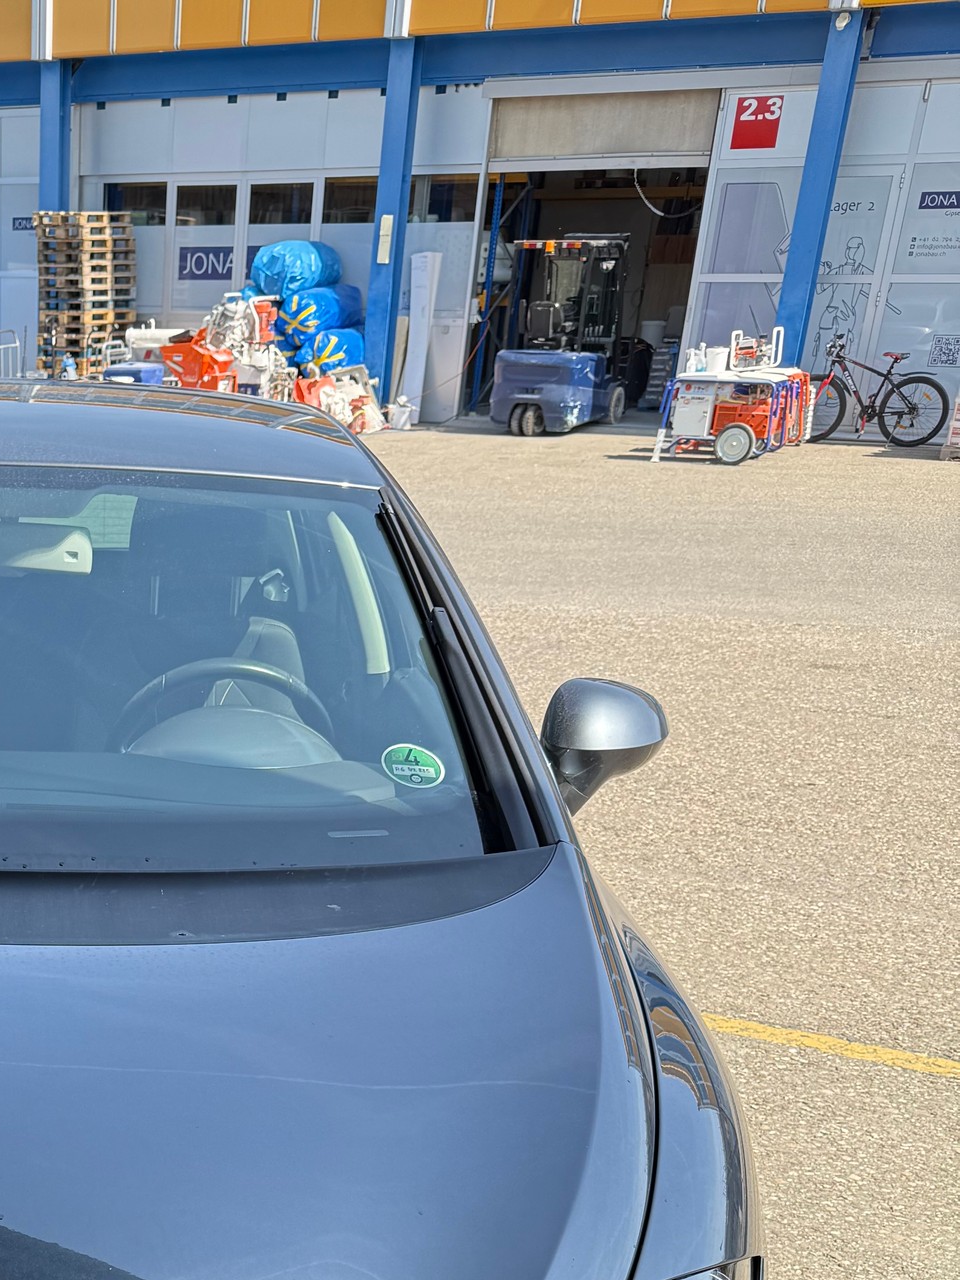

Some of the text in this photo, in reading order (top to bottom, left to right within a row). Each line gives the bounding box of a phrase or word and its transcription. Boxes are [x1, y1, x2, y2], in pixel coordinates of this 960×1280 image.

[740, 98, 782, 121] 2.3
[830, 201, 875, 215] ager 2
[922, 194, 957, 207] JONA
[182, 252, 234, 275] JONA
[404, 748, 420, 766] 4
